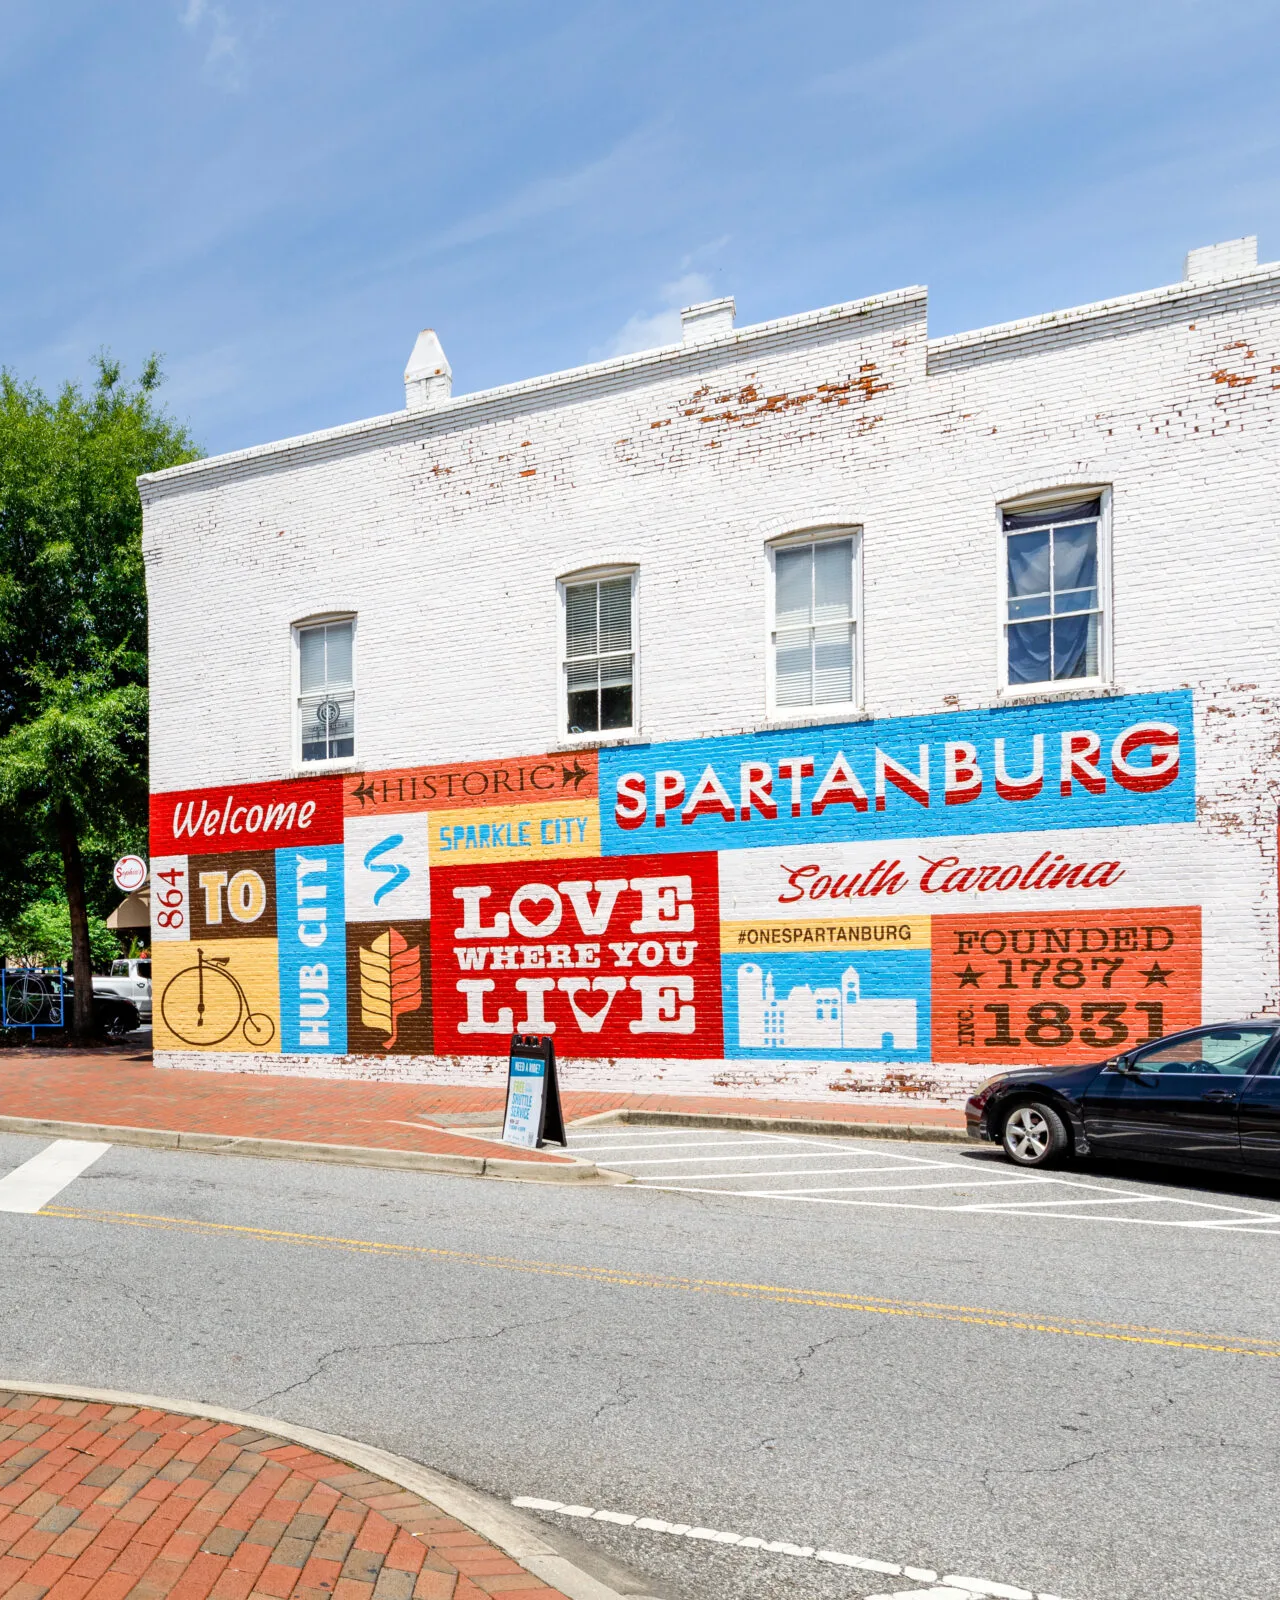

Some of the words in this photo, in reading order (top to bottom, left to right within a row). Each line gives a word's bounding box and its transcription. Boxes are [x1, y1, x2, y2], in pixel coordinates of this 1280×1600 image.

[381, 764, 555, 803] HISTORIC
[614, 721, 1180, 830] SPARTANBURG
[173, 796, 316, 839] Welcome
[439, 820, 532, 851] SPARKLE
[540, 816, 589, 846] CITY
[157, 867, 184, 929] 864
[199, 869, 266, 925] TO
[778, 858, 909, 904] South
[918, 849, 1126, 894] Carolina
[296, 854, 328, 947] CITY
[452, 875, 696, 939] LOVE
[453, 943, 601, 971] WHERE
[608, 941, 698, 967] YOU
[737, 924, 912, 945] #ONESPARTANBURG
[953, 926, 1174, 955] FOUNDED
[997, 957, 1124, 989] 1787
[299, 963, 330, 1046] HUB
[456, 975, 696, 1035] LIVE
[957, 1004, 975, 1047] INC.
[983, 1001, 1164, 1048] 1831
[510, 1105, 530, 1120] SERVICE
[512, 1092, 533, 1108] SHUTTLE
